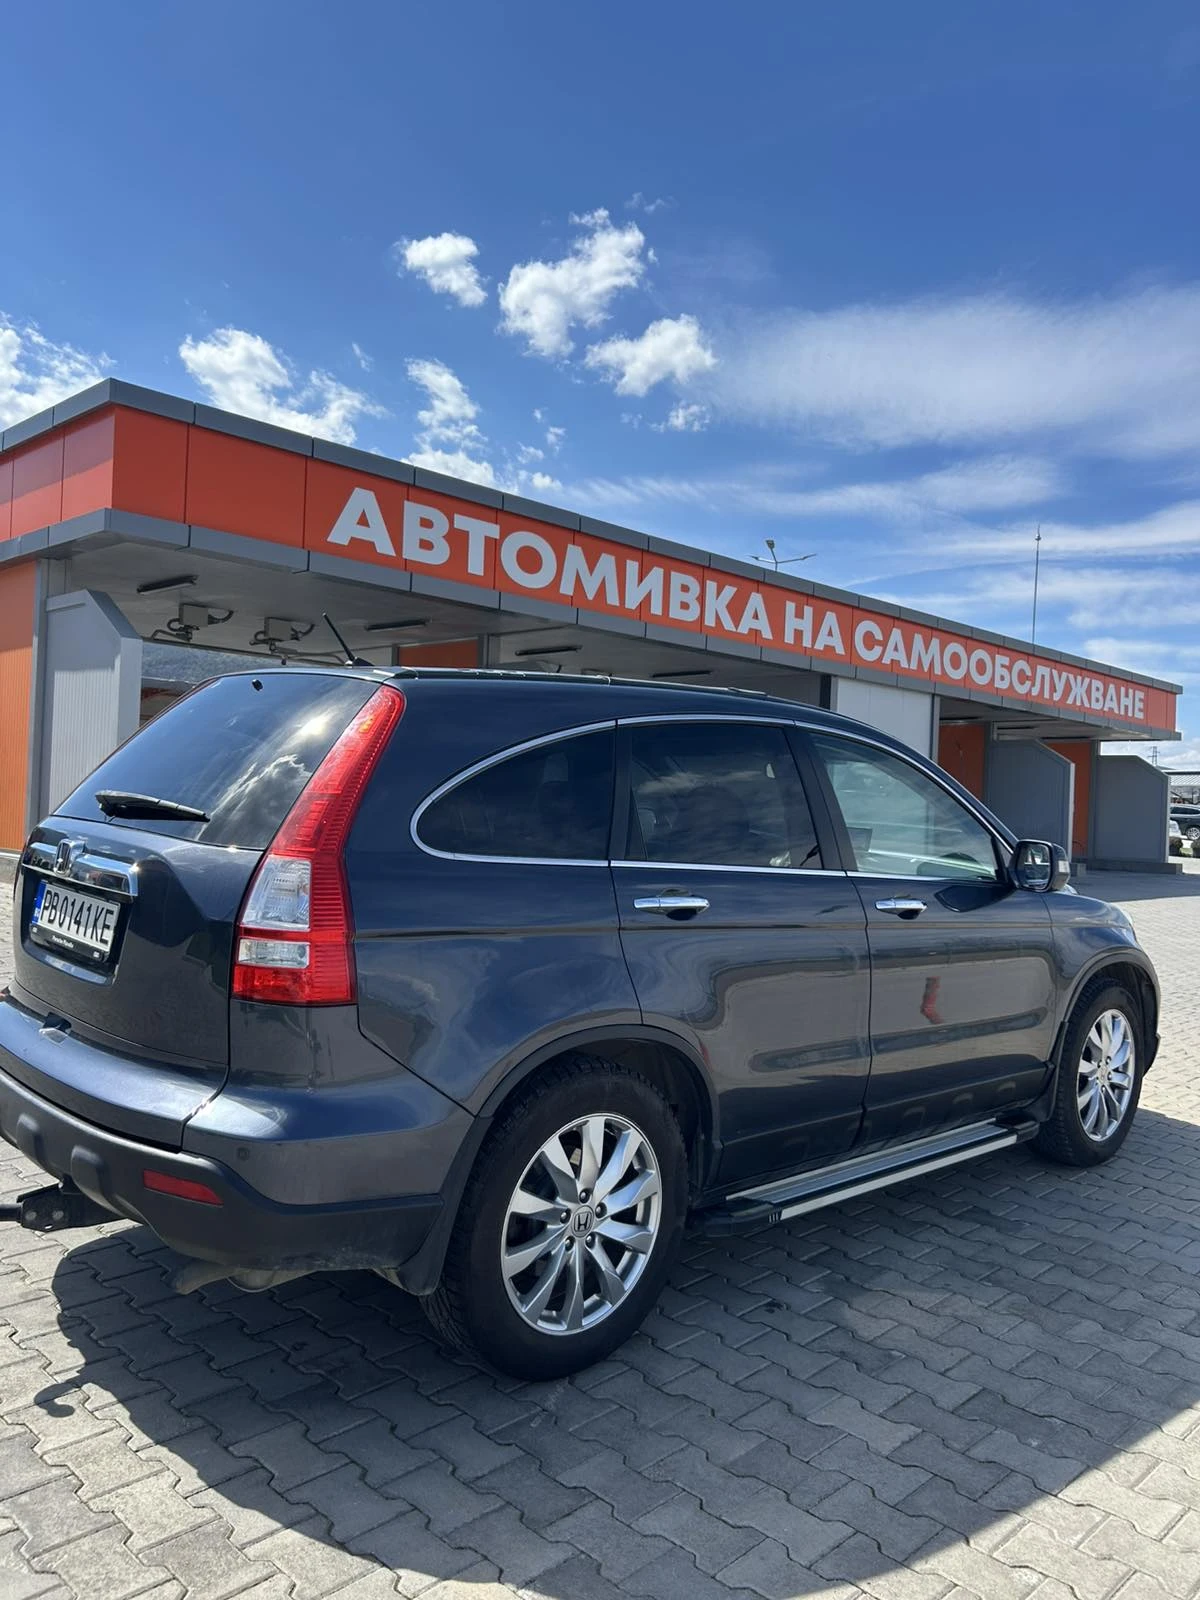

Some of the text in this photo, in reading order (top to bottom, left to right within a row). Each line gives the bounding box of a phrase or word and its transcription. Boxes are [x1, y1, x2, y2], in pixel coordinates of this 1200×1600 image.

[327, 487, 1145, 720] АВТОМИВКА НА САМООБСЛУЖВАНЕ
[41, 890, 114, 945] PB0141KE
